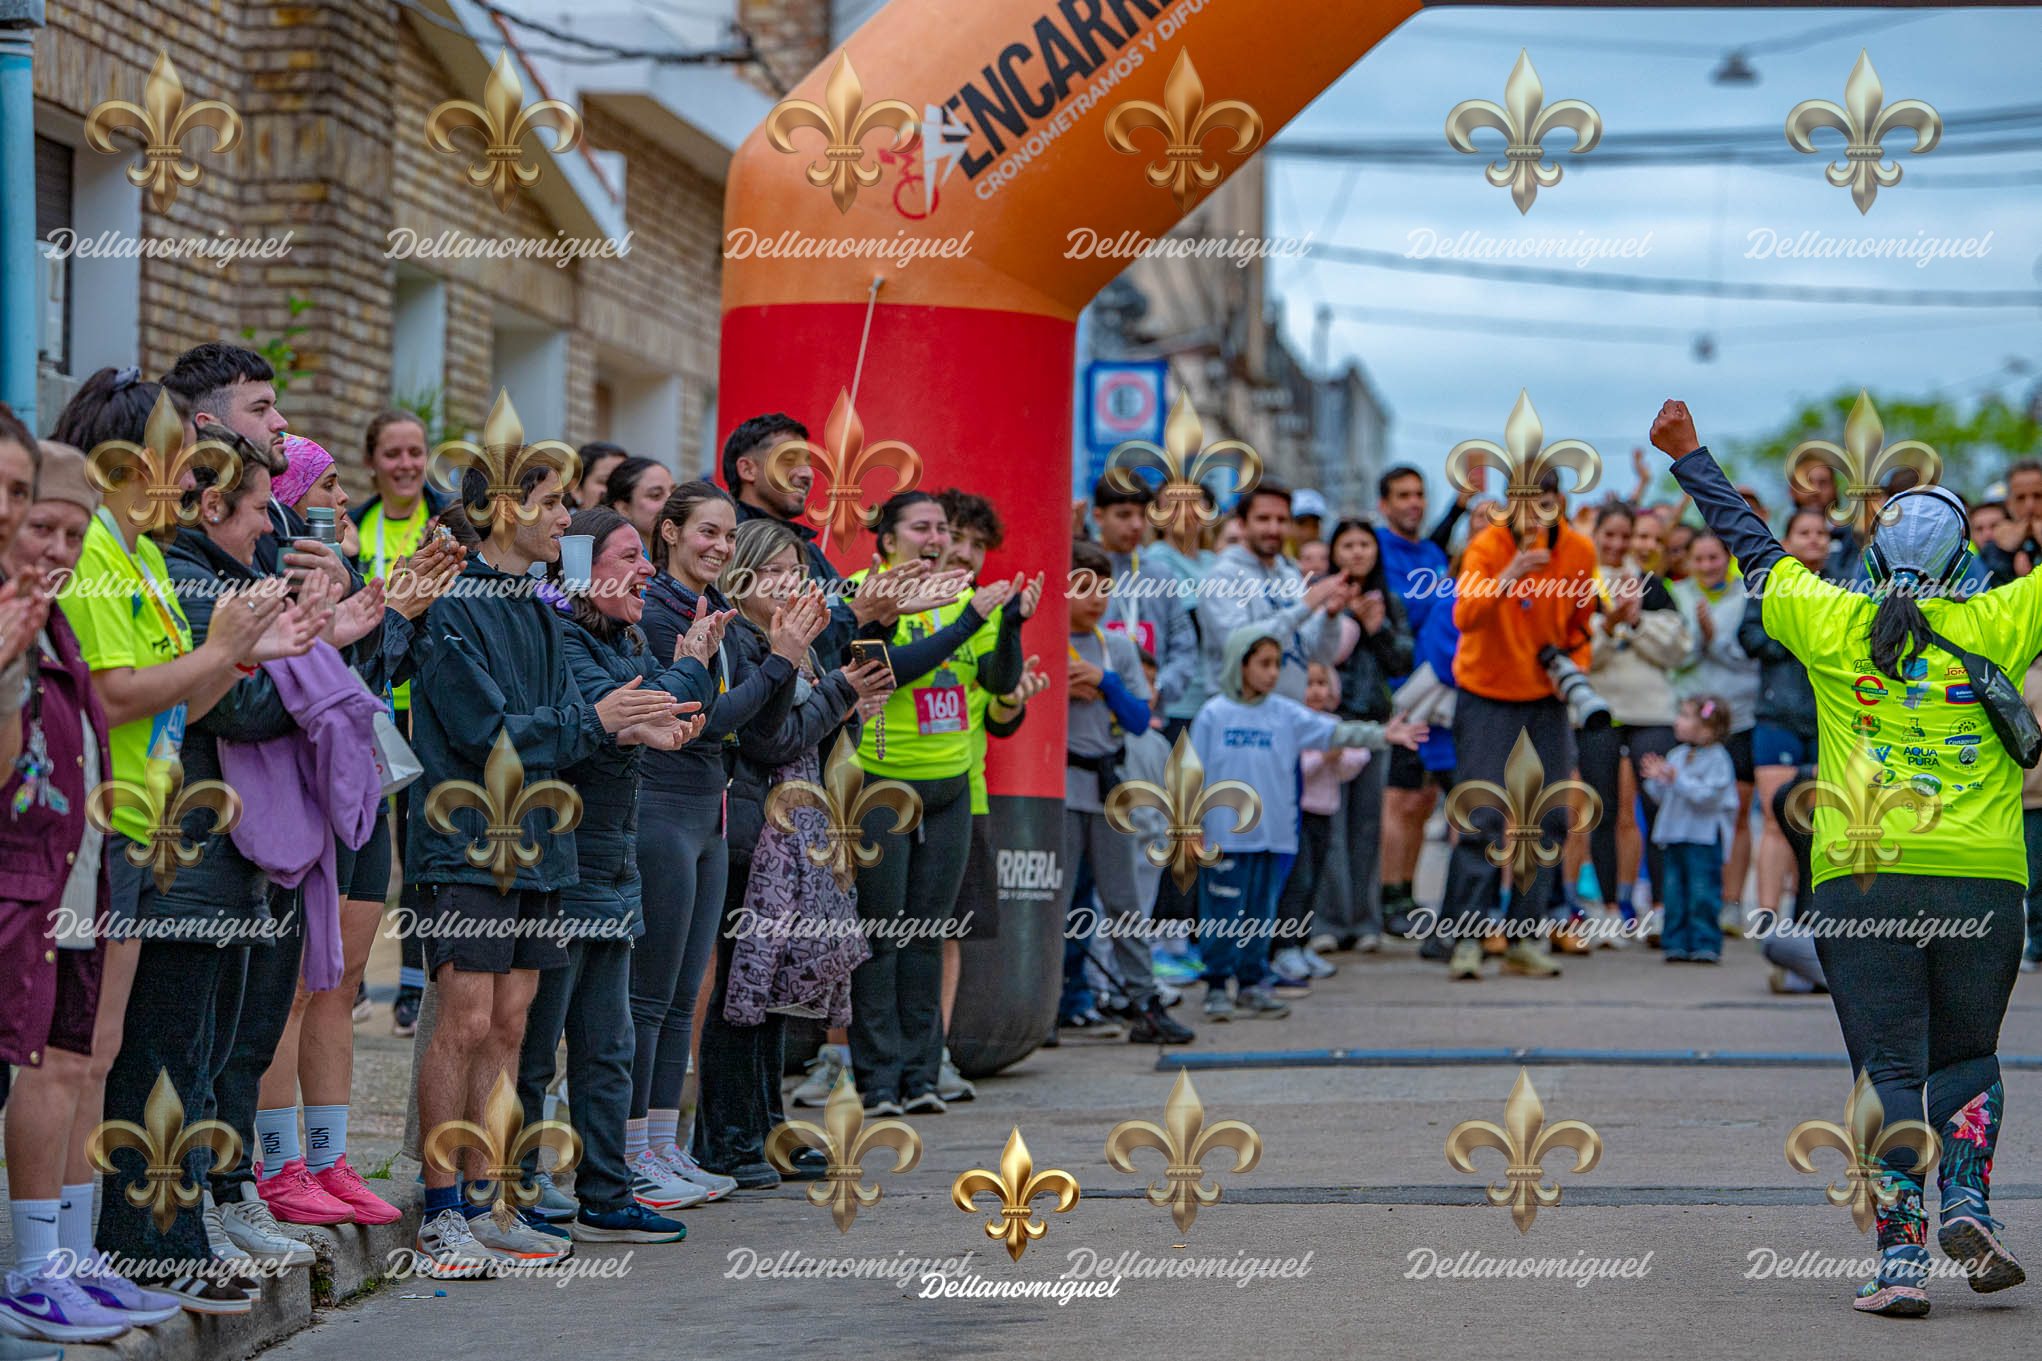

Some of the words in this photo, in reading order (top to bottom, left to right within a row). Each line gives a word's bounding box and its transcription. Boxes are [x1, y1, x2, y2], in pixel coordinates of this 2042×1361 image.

[940, 0, 1174, 180] ENCARR
[975, 47, 1144, 200] CRONOMETRAMOS
[1141, 32, 1157, 52] Y
[1156, 0, 1211, 41] DIFU
[924, 691, 959, 718] 160
[1903, 746, 1938, 757] AQUA
[1908, 756, 1941, 767] PURA
[262, 1131, 281, 1154] RUN
[310, 1127, 329, 1149] RUN
